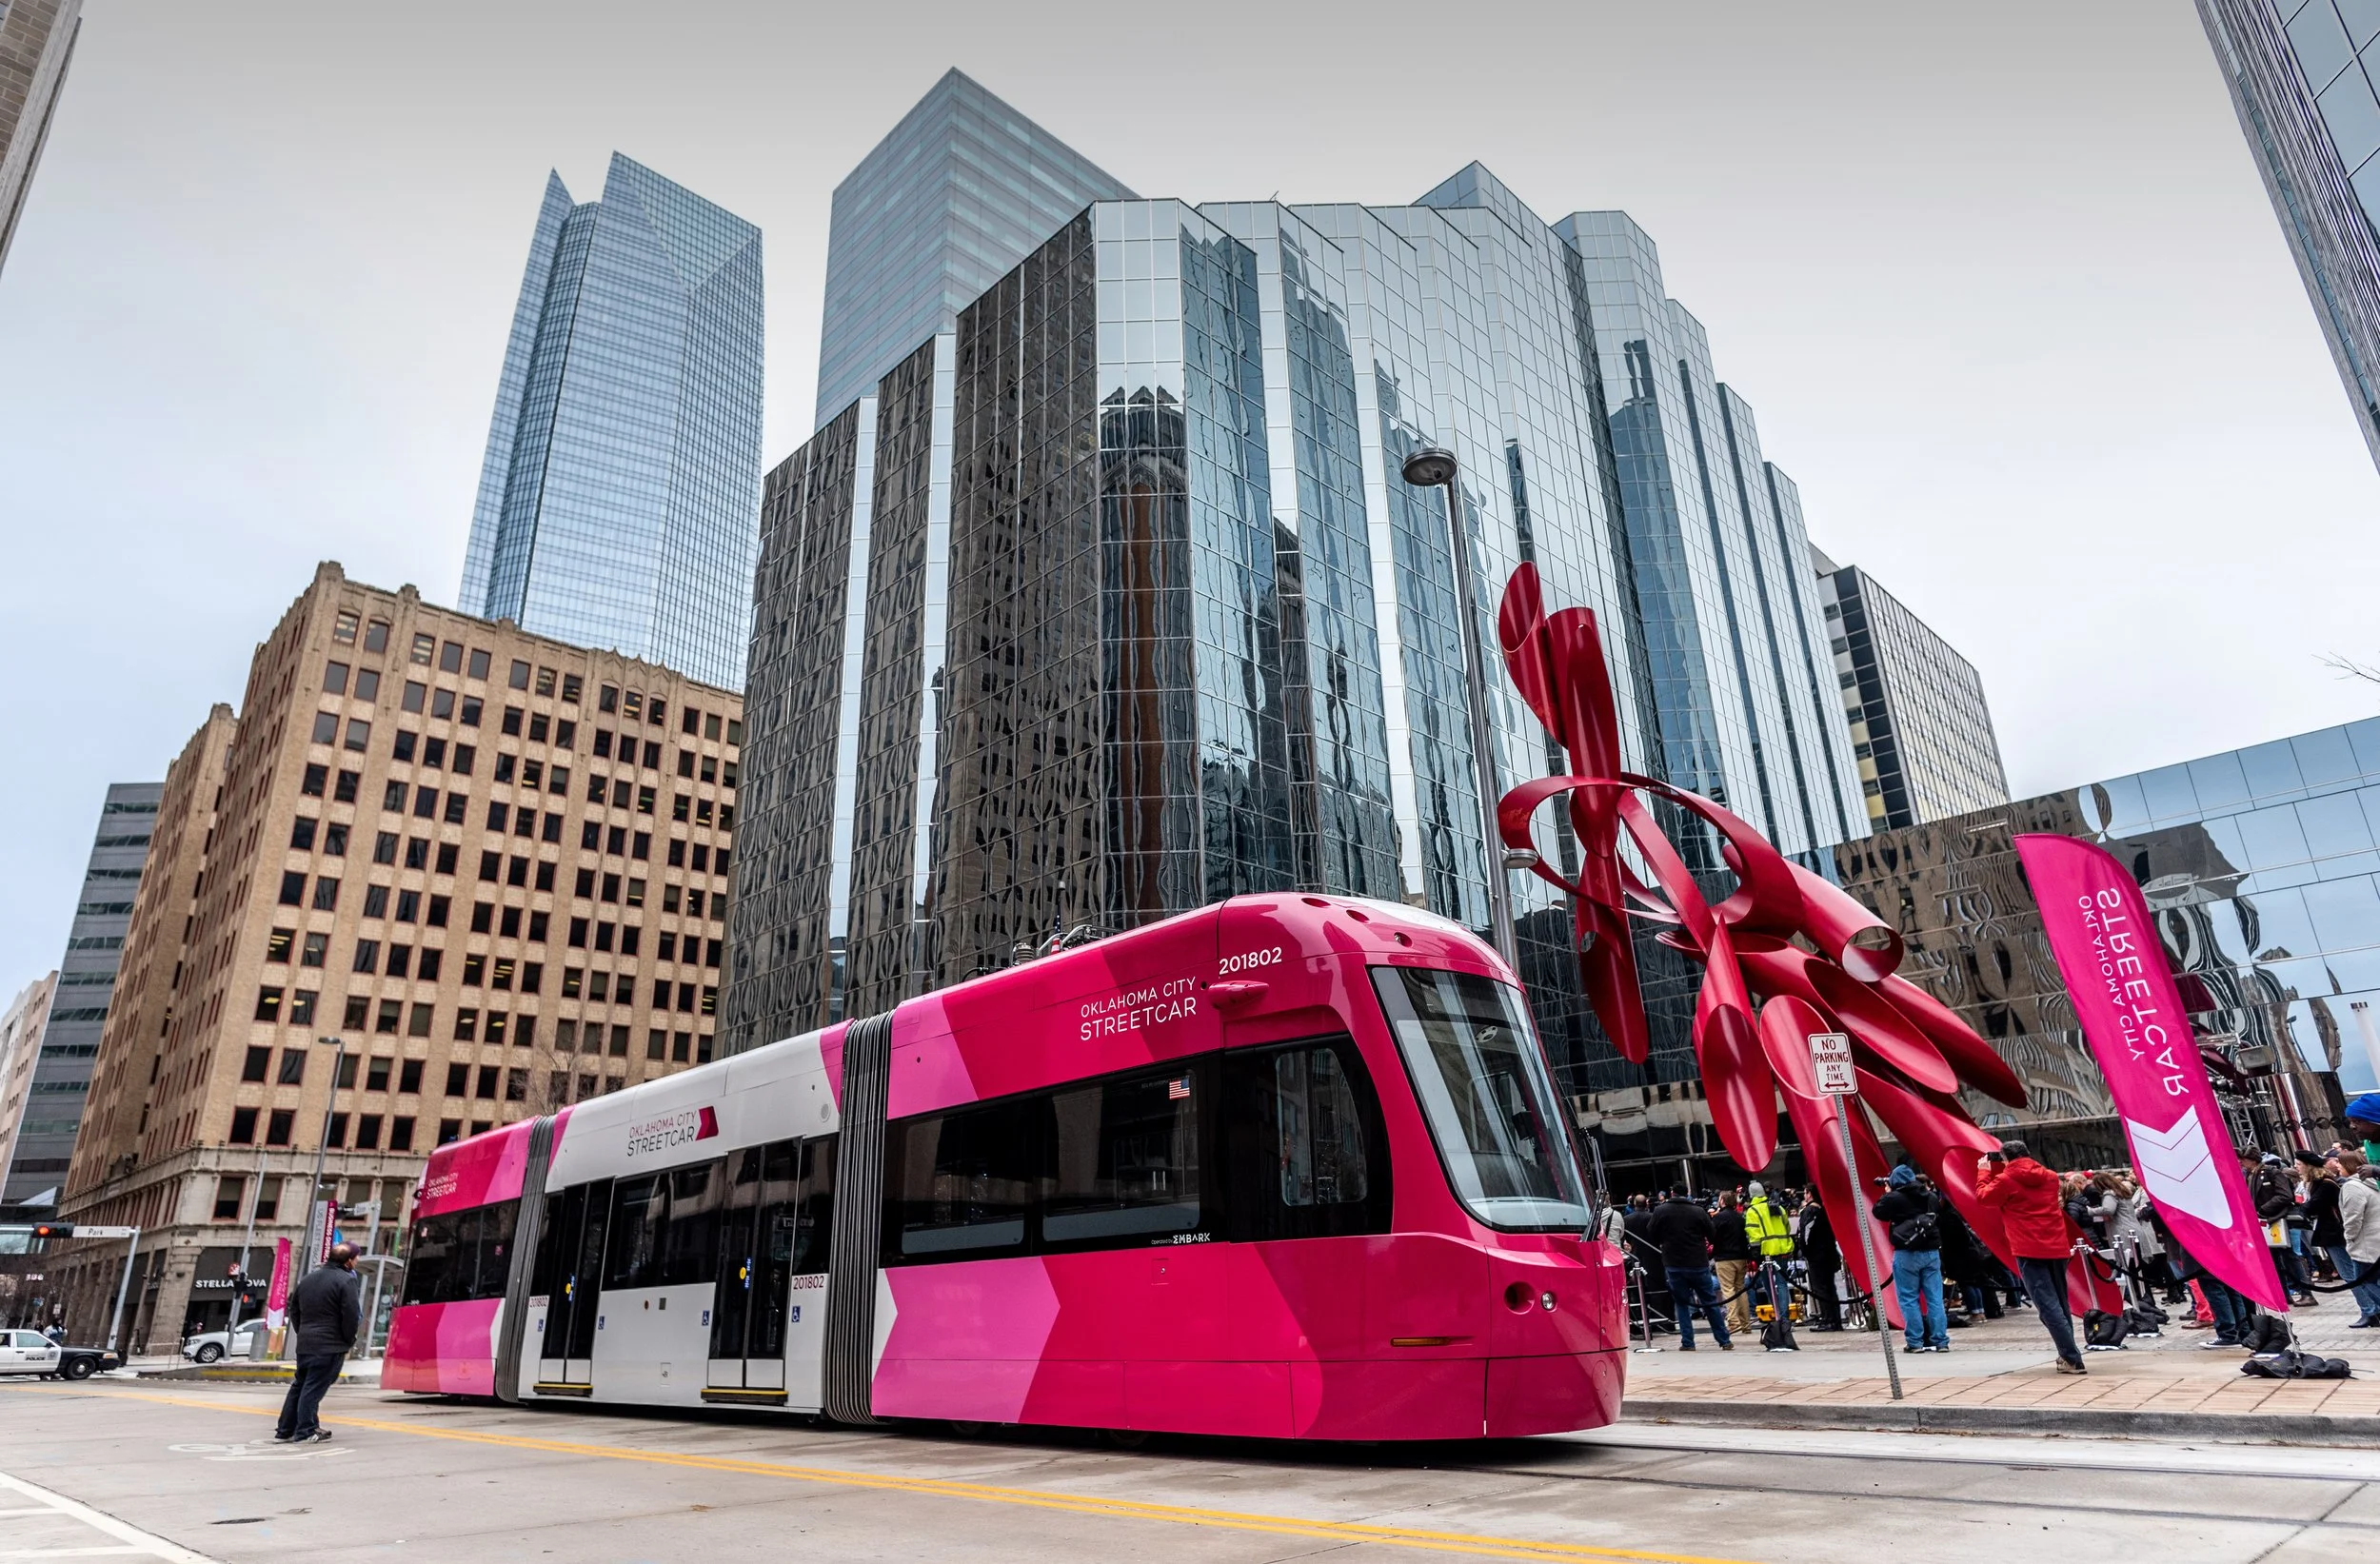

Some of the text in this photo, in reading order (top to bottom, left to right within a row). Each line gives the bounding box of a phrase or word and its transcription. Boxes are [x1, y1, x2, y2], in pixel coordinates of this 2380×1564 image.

[1219, 946, 1282, 975] 201802
[1081, 976, 1196, 1018] OKLAHOMA CITY
[1081, 997, 1197, 1041] STREETCAR
[1821, 1039, 1836, 1050] NO
[1815, 1052, 1849, 1063] PARKING
[629, 1110, 697, 1138] OKLAHOMA CITY
[627, 1126, 695, 1157] STREETCAR
[88, 1227, 103, 1236] Park
[195, 1278, 267, 1288] STELLA OVA
[793, 1276, 824, 1290] 201802
